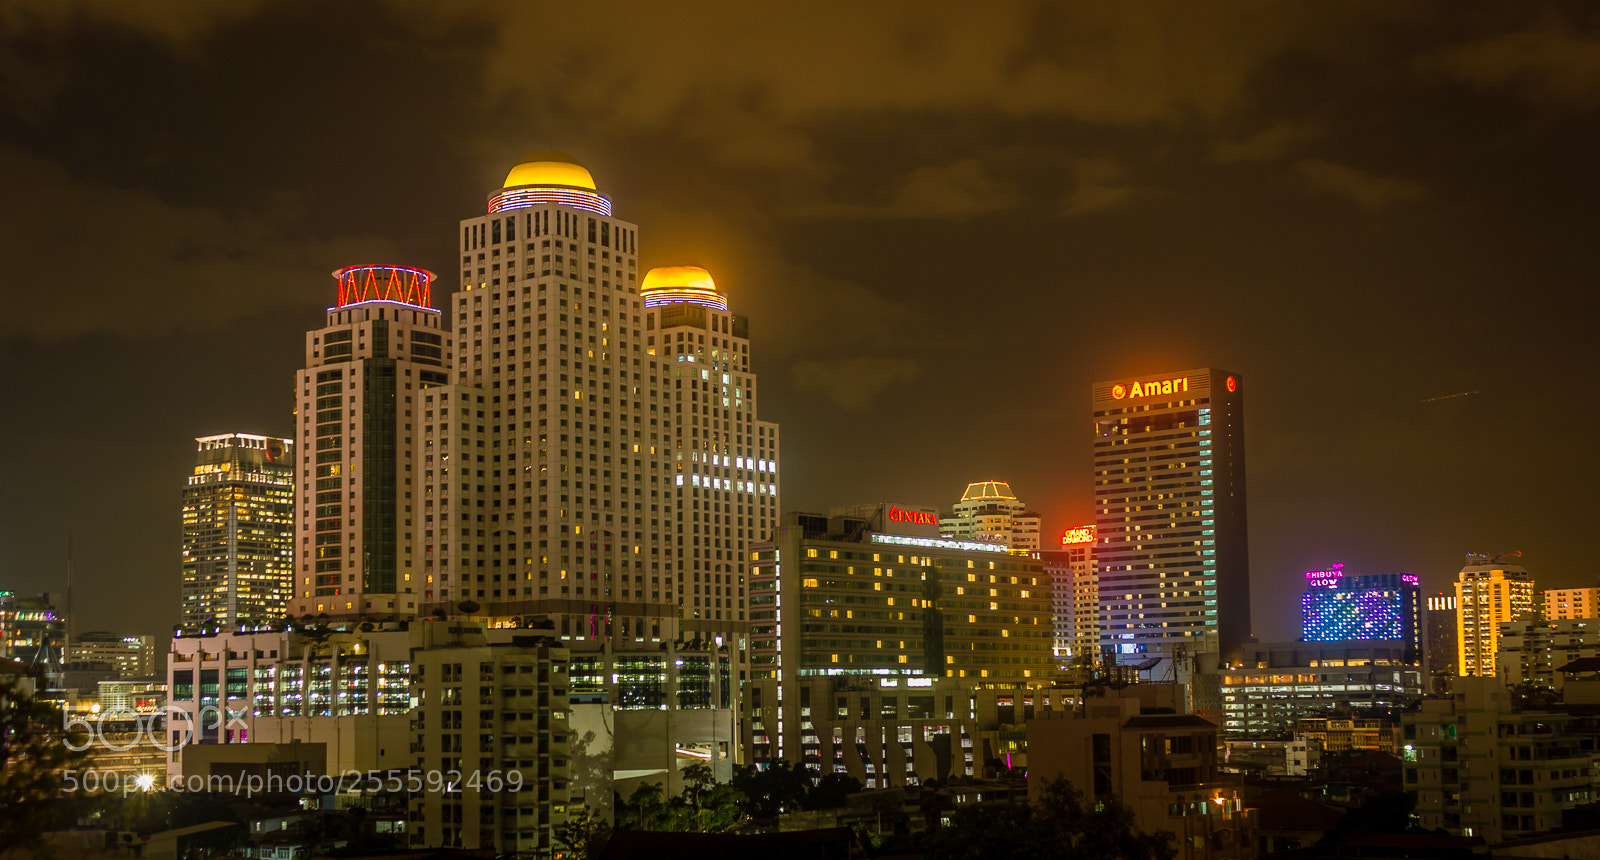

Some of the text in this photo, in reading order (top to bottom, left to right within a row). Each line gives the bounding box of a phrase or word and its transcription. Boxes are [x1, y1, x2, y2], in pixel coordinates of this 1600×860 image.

[1129, 377, 1188, 399] Amari
[890, 505, 938, 525] CENTARA
[1305, 570, 1343, 579] SHIBUYA
[1310, 579, 1338, 587] GLOW
